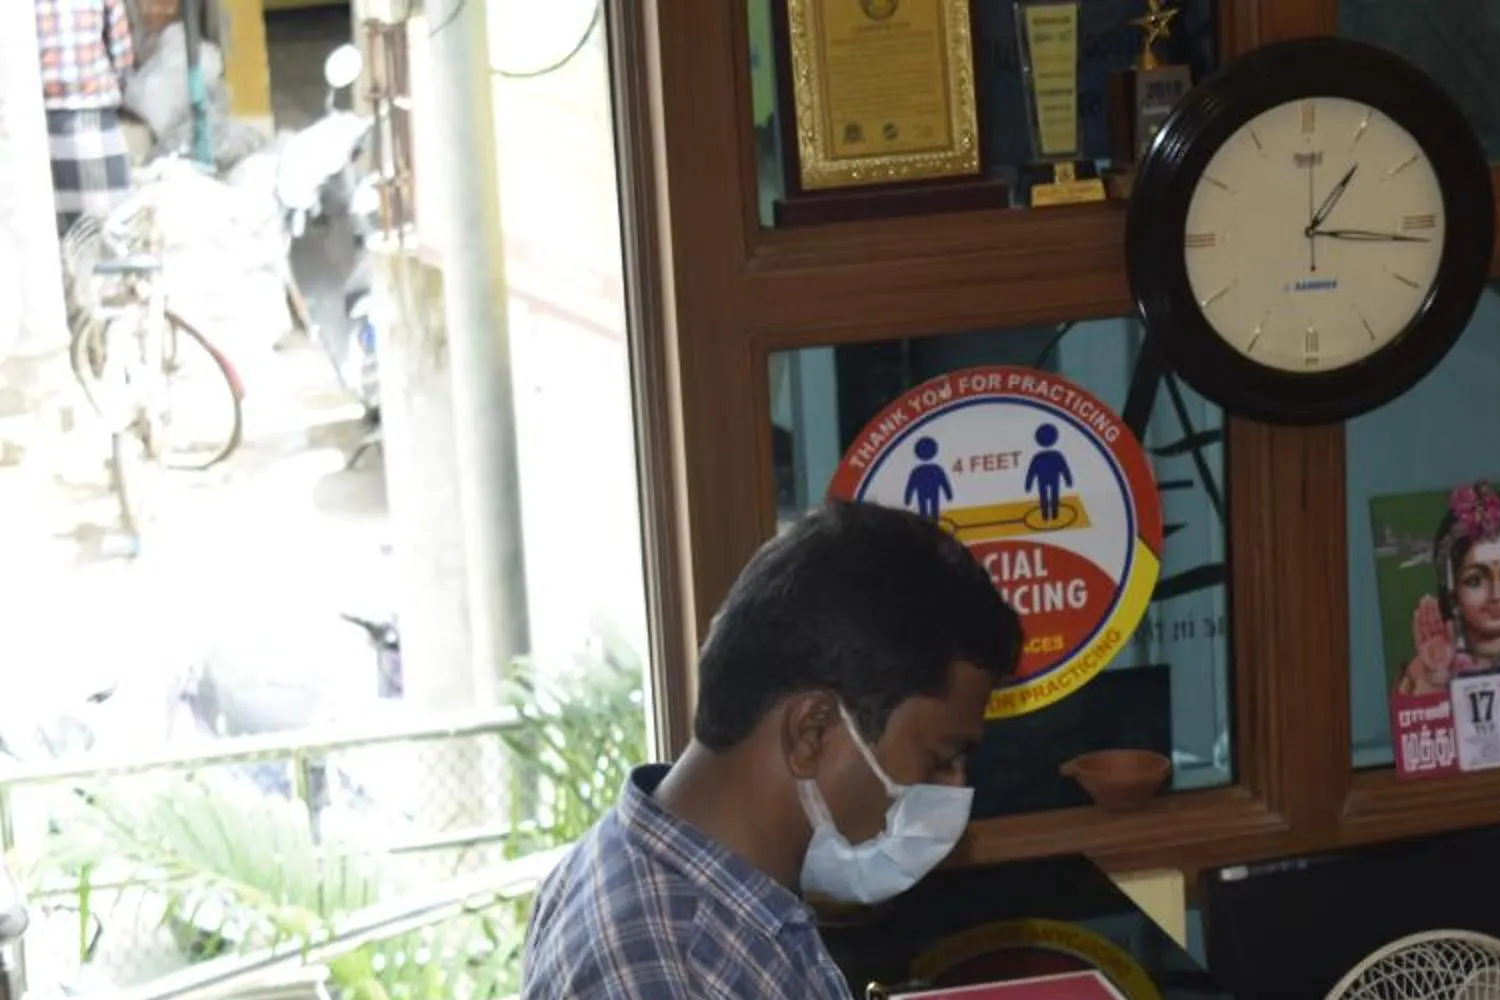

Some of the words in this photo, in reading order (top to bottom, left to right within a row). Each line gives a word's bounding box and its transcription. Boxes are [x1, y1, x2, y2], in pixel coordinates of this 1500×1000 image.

[849, 407, 910, 471] THANK
[958, 371, 1001, 395] FOR
[1007, 373, 1121, 444] PRACTICING
[952, 456, 964, 475] 4
[969, 450, 1023, 474] FEET
[985, 547, 1048, 582] CIAL
[1003, 578, 1088, 616] CING
[1018, 627, 1121, 706] PRACTICING
[1468, 690, 1496, 723] 17
